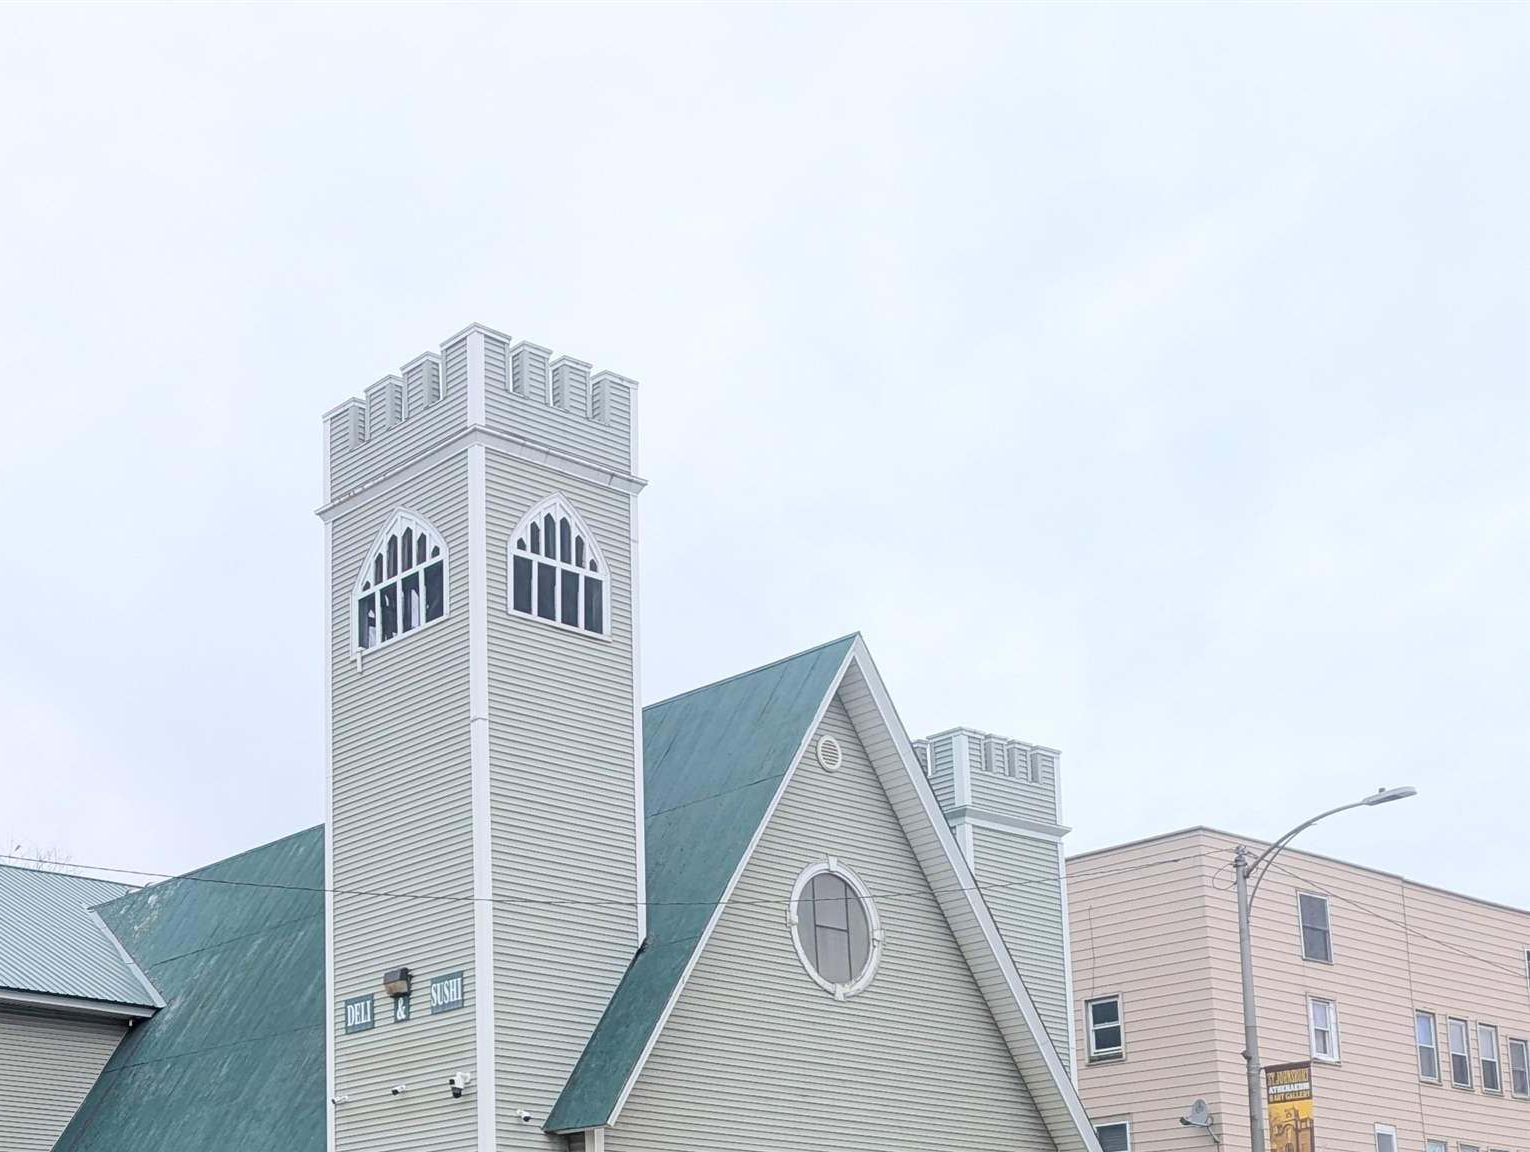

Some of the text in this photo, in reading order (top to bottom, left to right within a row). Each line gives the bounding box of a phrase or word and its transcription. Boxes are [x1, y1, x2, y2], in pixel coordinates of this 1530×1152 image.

[347, 977, 462, 1027] DELI & SUSHI
